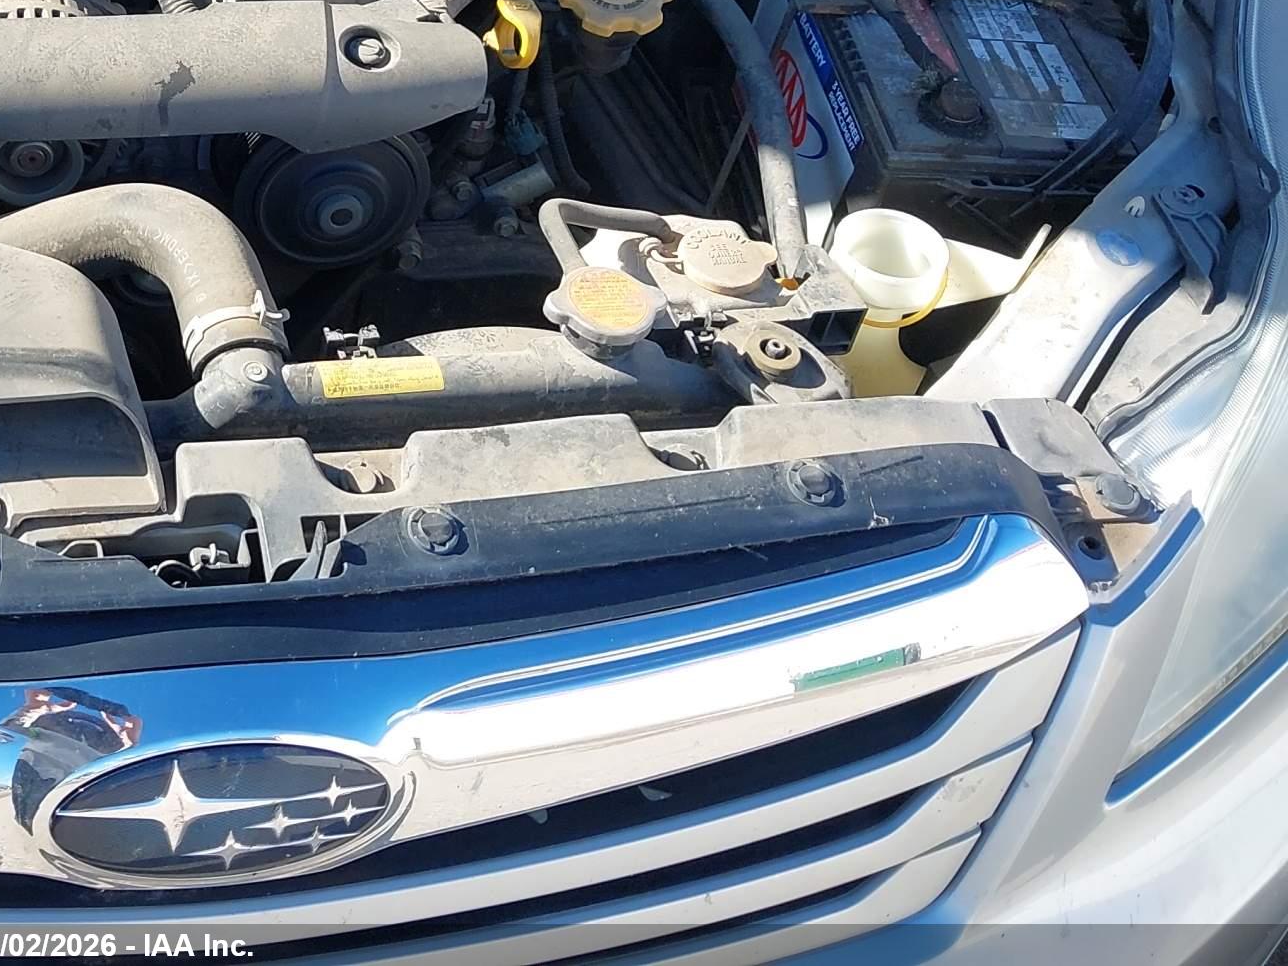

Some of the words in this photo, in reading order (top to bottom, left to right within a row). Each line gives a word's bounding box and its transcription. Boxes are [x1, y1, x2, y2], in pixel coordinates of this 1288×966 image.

[799, 12, 827, 68] BATTERY
[828, 92, 856, 151] REPLACEMENT
[834, 87, 850, 115] YEAR
[843, 114, 861, 145] FREE
[685, 225, 751, 249] COOLANT
